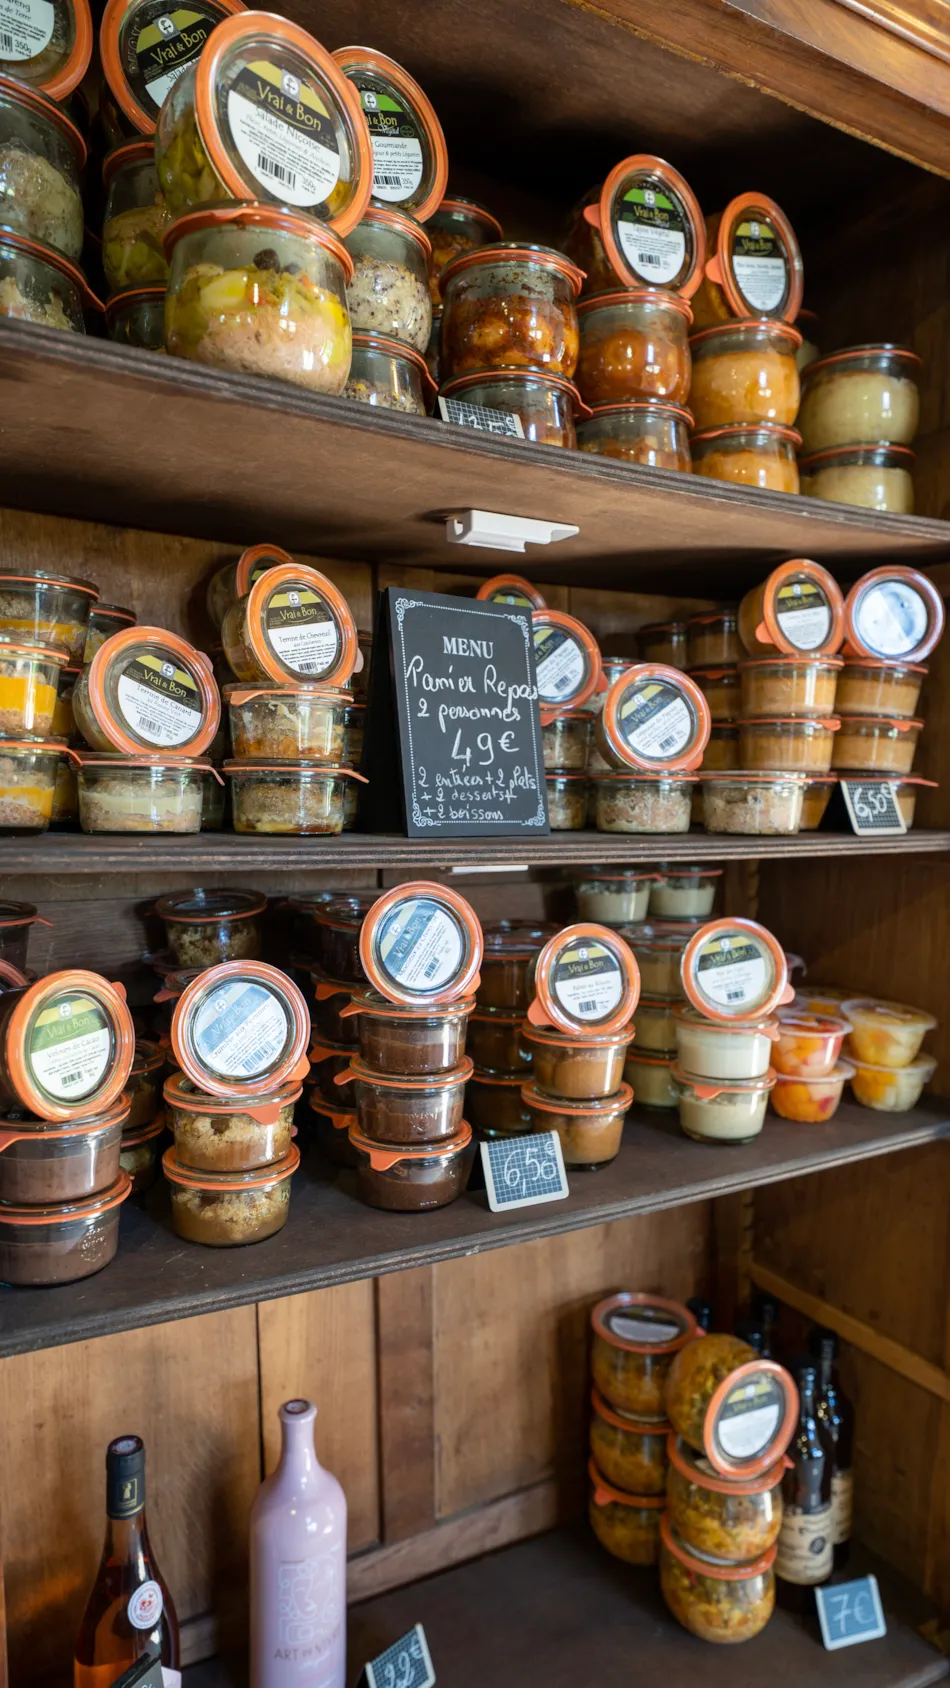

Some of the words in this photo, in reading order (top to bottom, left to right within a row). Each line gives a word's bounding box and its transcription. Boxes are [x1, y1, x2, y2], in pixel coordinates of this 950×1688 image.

[150, 44, 178, 64] Vrai
[176, 43, 185, 52] &
[181, 29, 207, 47] Bon
[257, 80, 284, 110] Vrai
[285, 103, 294, 115] &
[296, 103, 321, 131] Bon
[378, 112, 398, 126] Bon
[255, 107, 284, 132] Salade
[286, 125, 321, 152] Niçoise
[374, 140, 407, 148] Gourmande
[633, 205, 649, 217] Vrai
[653, 208, 669, 220] Bon
[280, 609, 296, 620] Vrai
[301, 606, 317, 617] Bon
[278, 635, 298, 643] Terrine
[306, 629, 331, 639] Chevreuil
[443, 636, 493, 659] MENU
[144, 669, 161, 686] Vrai
[169, 681, 187, 697] Bon
[406, 655, 476, 693] Panier
[484, 664, 538, 713] Repas
[136, 685, 160, 701] Terrine
[161, 697, 170, 705] de
[170, 701, 192, 716] Canard
[631, 709, 646, 722] Vrai
[647, 697, 662, 709] Bon
[417, 698, 430, 717] 2
[439, 704, 520, 733] personnes
[418, 766, 429, 787] 2
[436, 764, 483, 787] entrées
[509, 765, 536, 795] plats
[436, 787, 445, 801] 2
[449, 803, 503, 820] boissons
[853, 783, 892, 822] 6,50€
[393, 939, 408, 958] Vrai
[409, 917, 421, 932] Bon
[568, 964, 583, 973] Vrai
[588, 960, 604, 969] Bon
[47, 1026, 65, 1038] Vrai
[72, 1017, 90, 1028] Bon
[211, 1018, 228, 1034] Vrai
[232, 999, 252, 1015] Bon
[211, 1036, 234, 1058] Crumble
[244, 1003, 270, 1025] Pommes
[504, 1141, 555, 1196] 6,50€
[831, 1591, 875, 1634] 7€
[274, 1648, 298, 1661] ART
